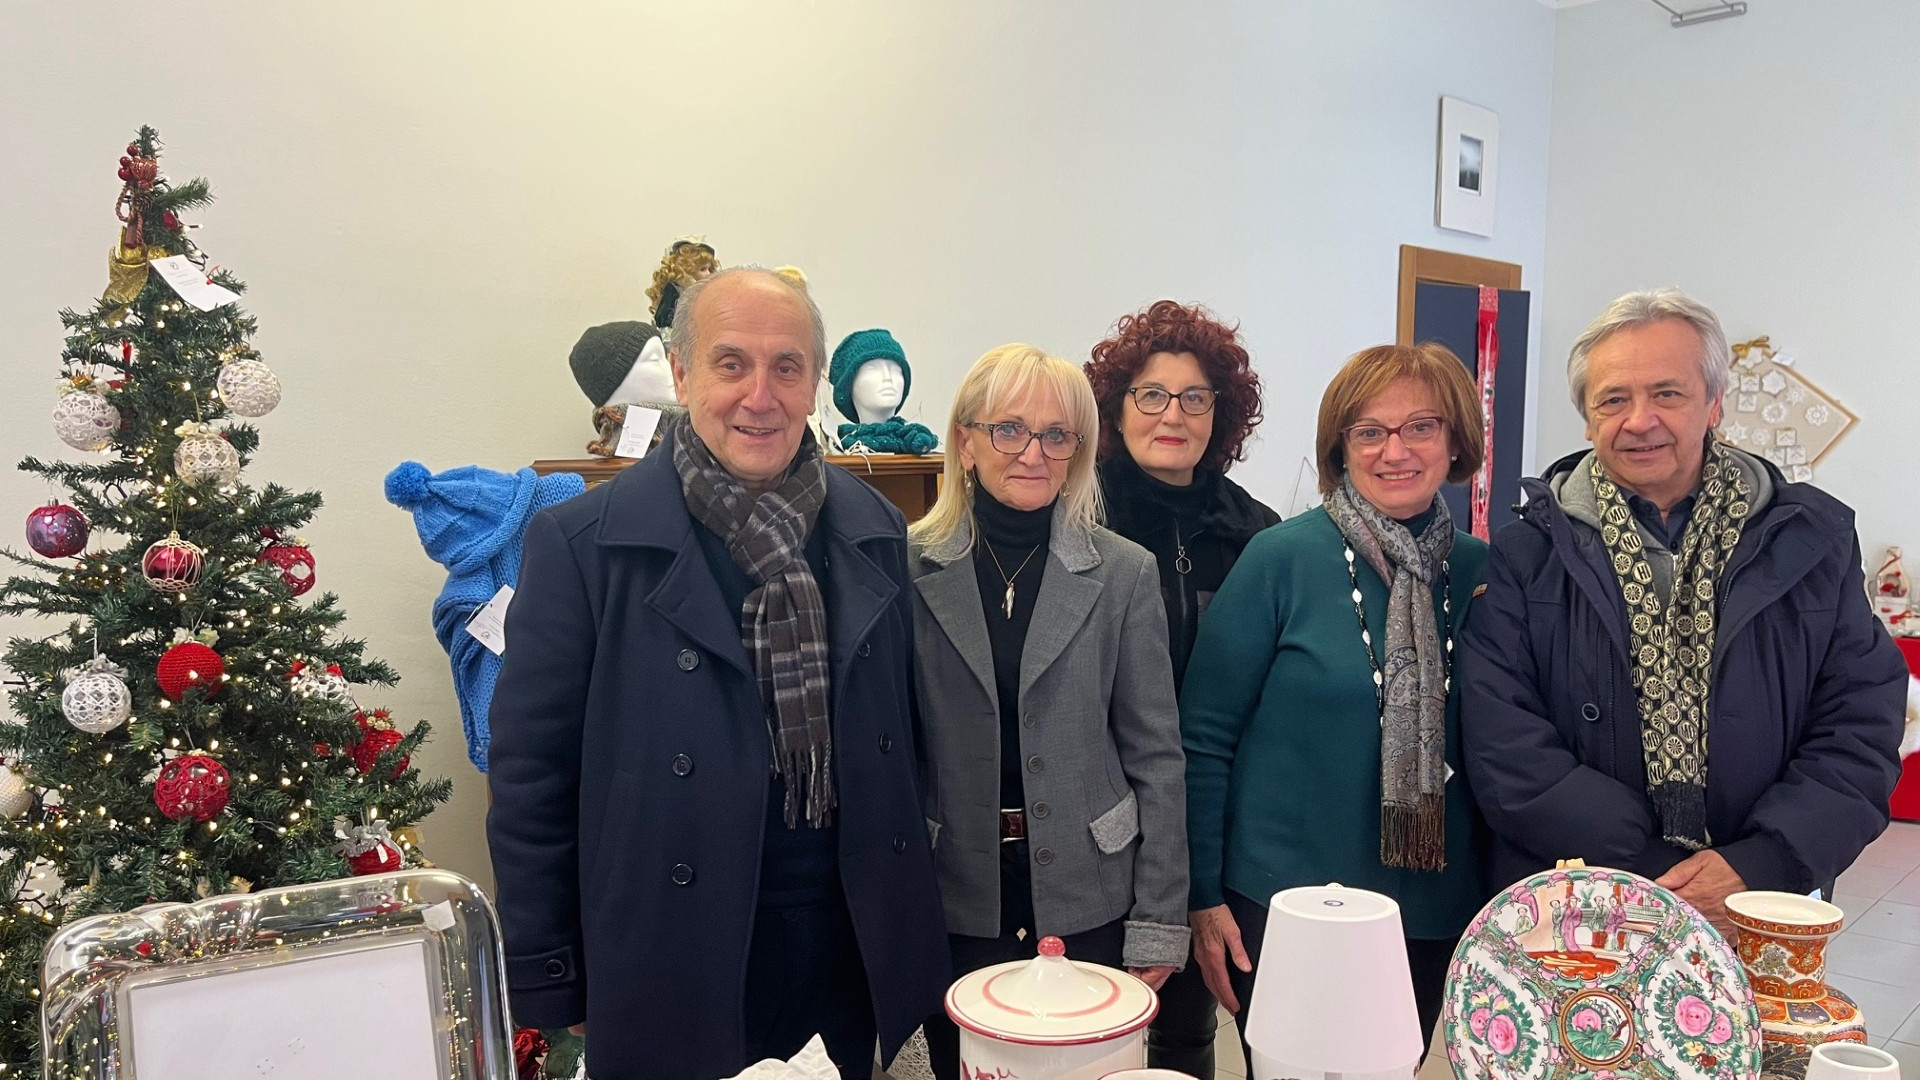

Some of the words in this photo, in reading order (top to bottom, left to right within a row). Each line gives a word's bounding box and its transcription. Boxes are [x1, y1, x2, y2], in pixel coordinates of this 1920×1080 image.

[1600, 482, 1614, 497] SC
[1608, 505, 1628, 522] MO
[1622, 534, 1641, 551] NO
[1637, 564, 1651, 580] HI
[1646, 595, 1660, 612] SC
[1650, 764, 1665, 781] NO
